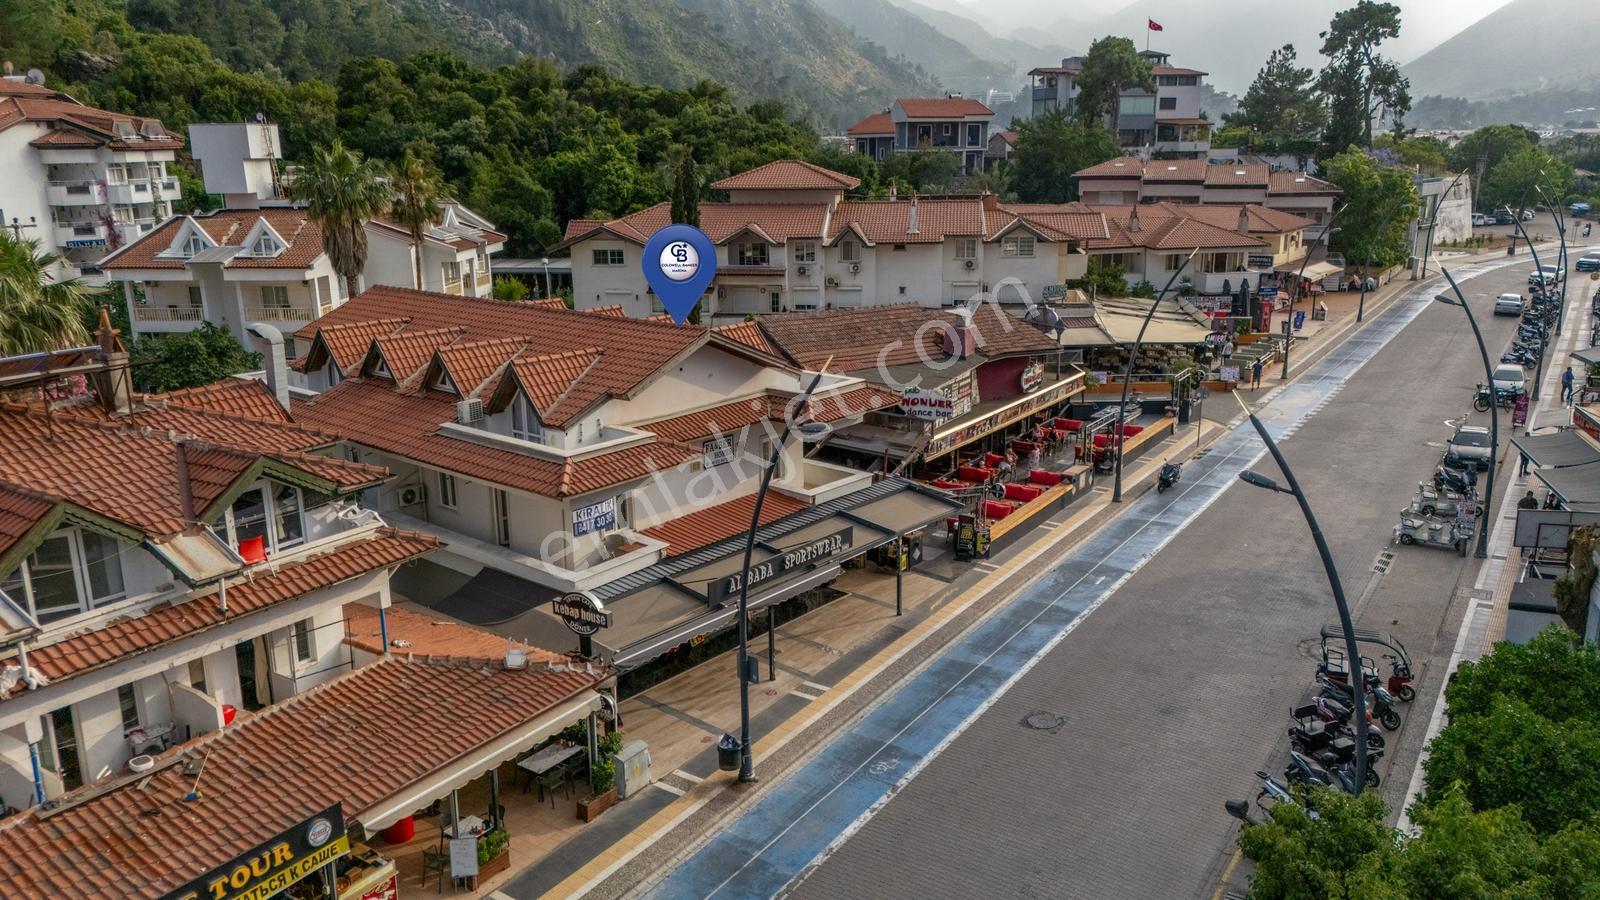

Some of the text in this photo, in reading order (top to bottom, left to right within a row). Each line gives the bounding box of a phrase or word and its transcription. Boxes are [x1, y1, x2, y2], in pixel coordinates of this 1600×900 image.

[901, 397, 953, 409] WONDER
[907, 408, 933, 417] dance
[784, 534, 842, 570] SPORTSWEAR
[728, 563, 774, 593] ALBABA
[554, 602, 607, 626] Kebap house
[209, 842, 295, 900] TOUR
[237, 843, 338, 900] АТЬСЯ К САШЕ
